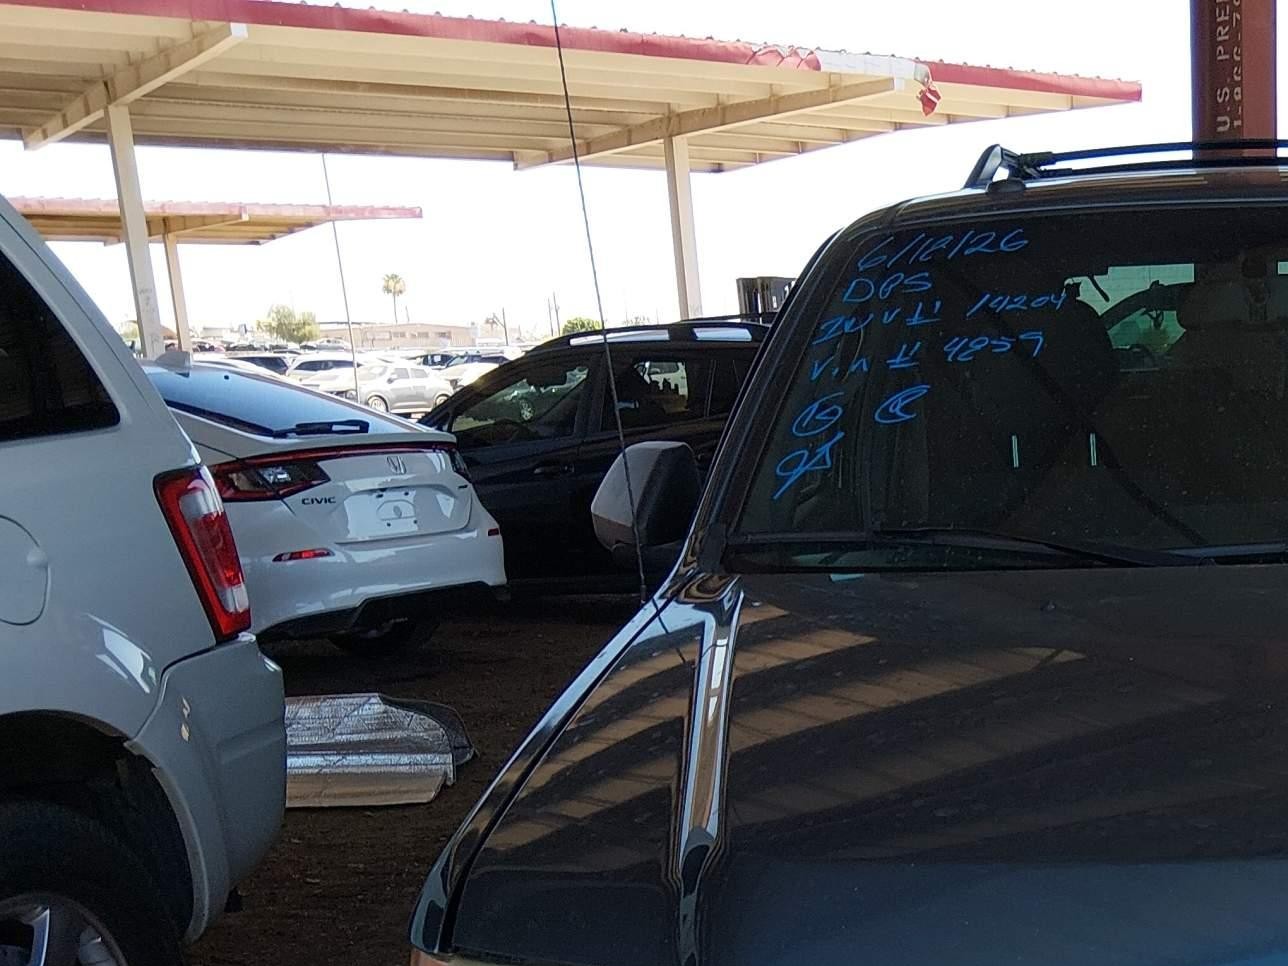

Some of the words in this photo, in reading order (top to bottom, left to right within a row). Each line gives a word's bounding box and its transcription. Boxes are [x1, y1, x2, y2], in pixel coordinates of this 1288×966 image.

[1216, 0, 1230, 61] PRE
[1216, 77, 1231, 132] U.S.
[843, 273, 932, 302] DPS
[301, 496, 336, 505] CIVIC
